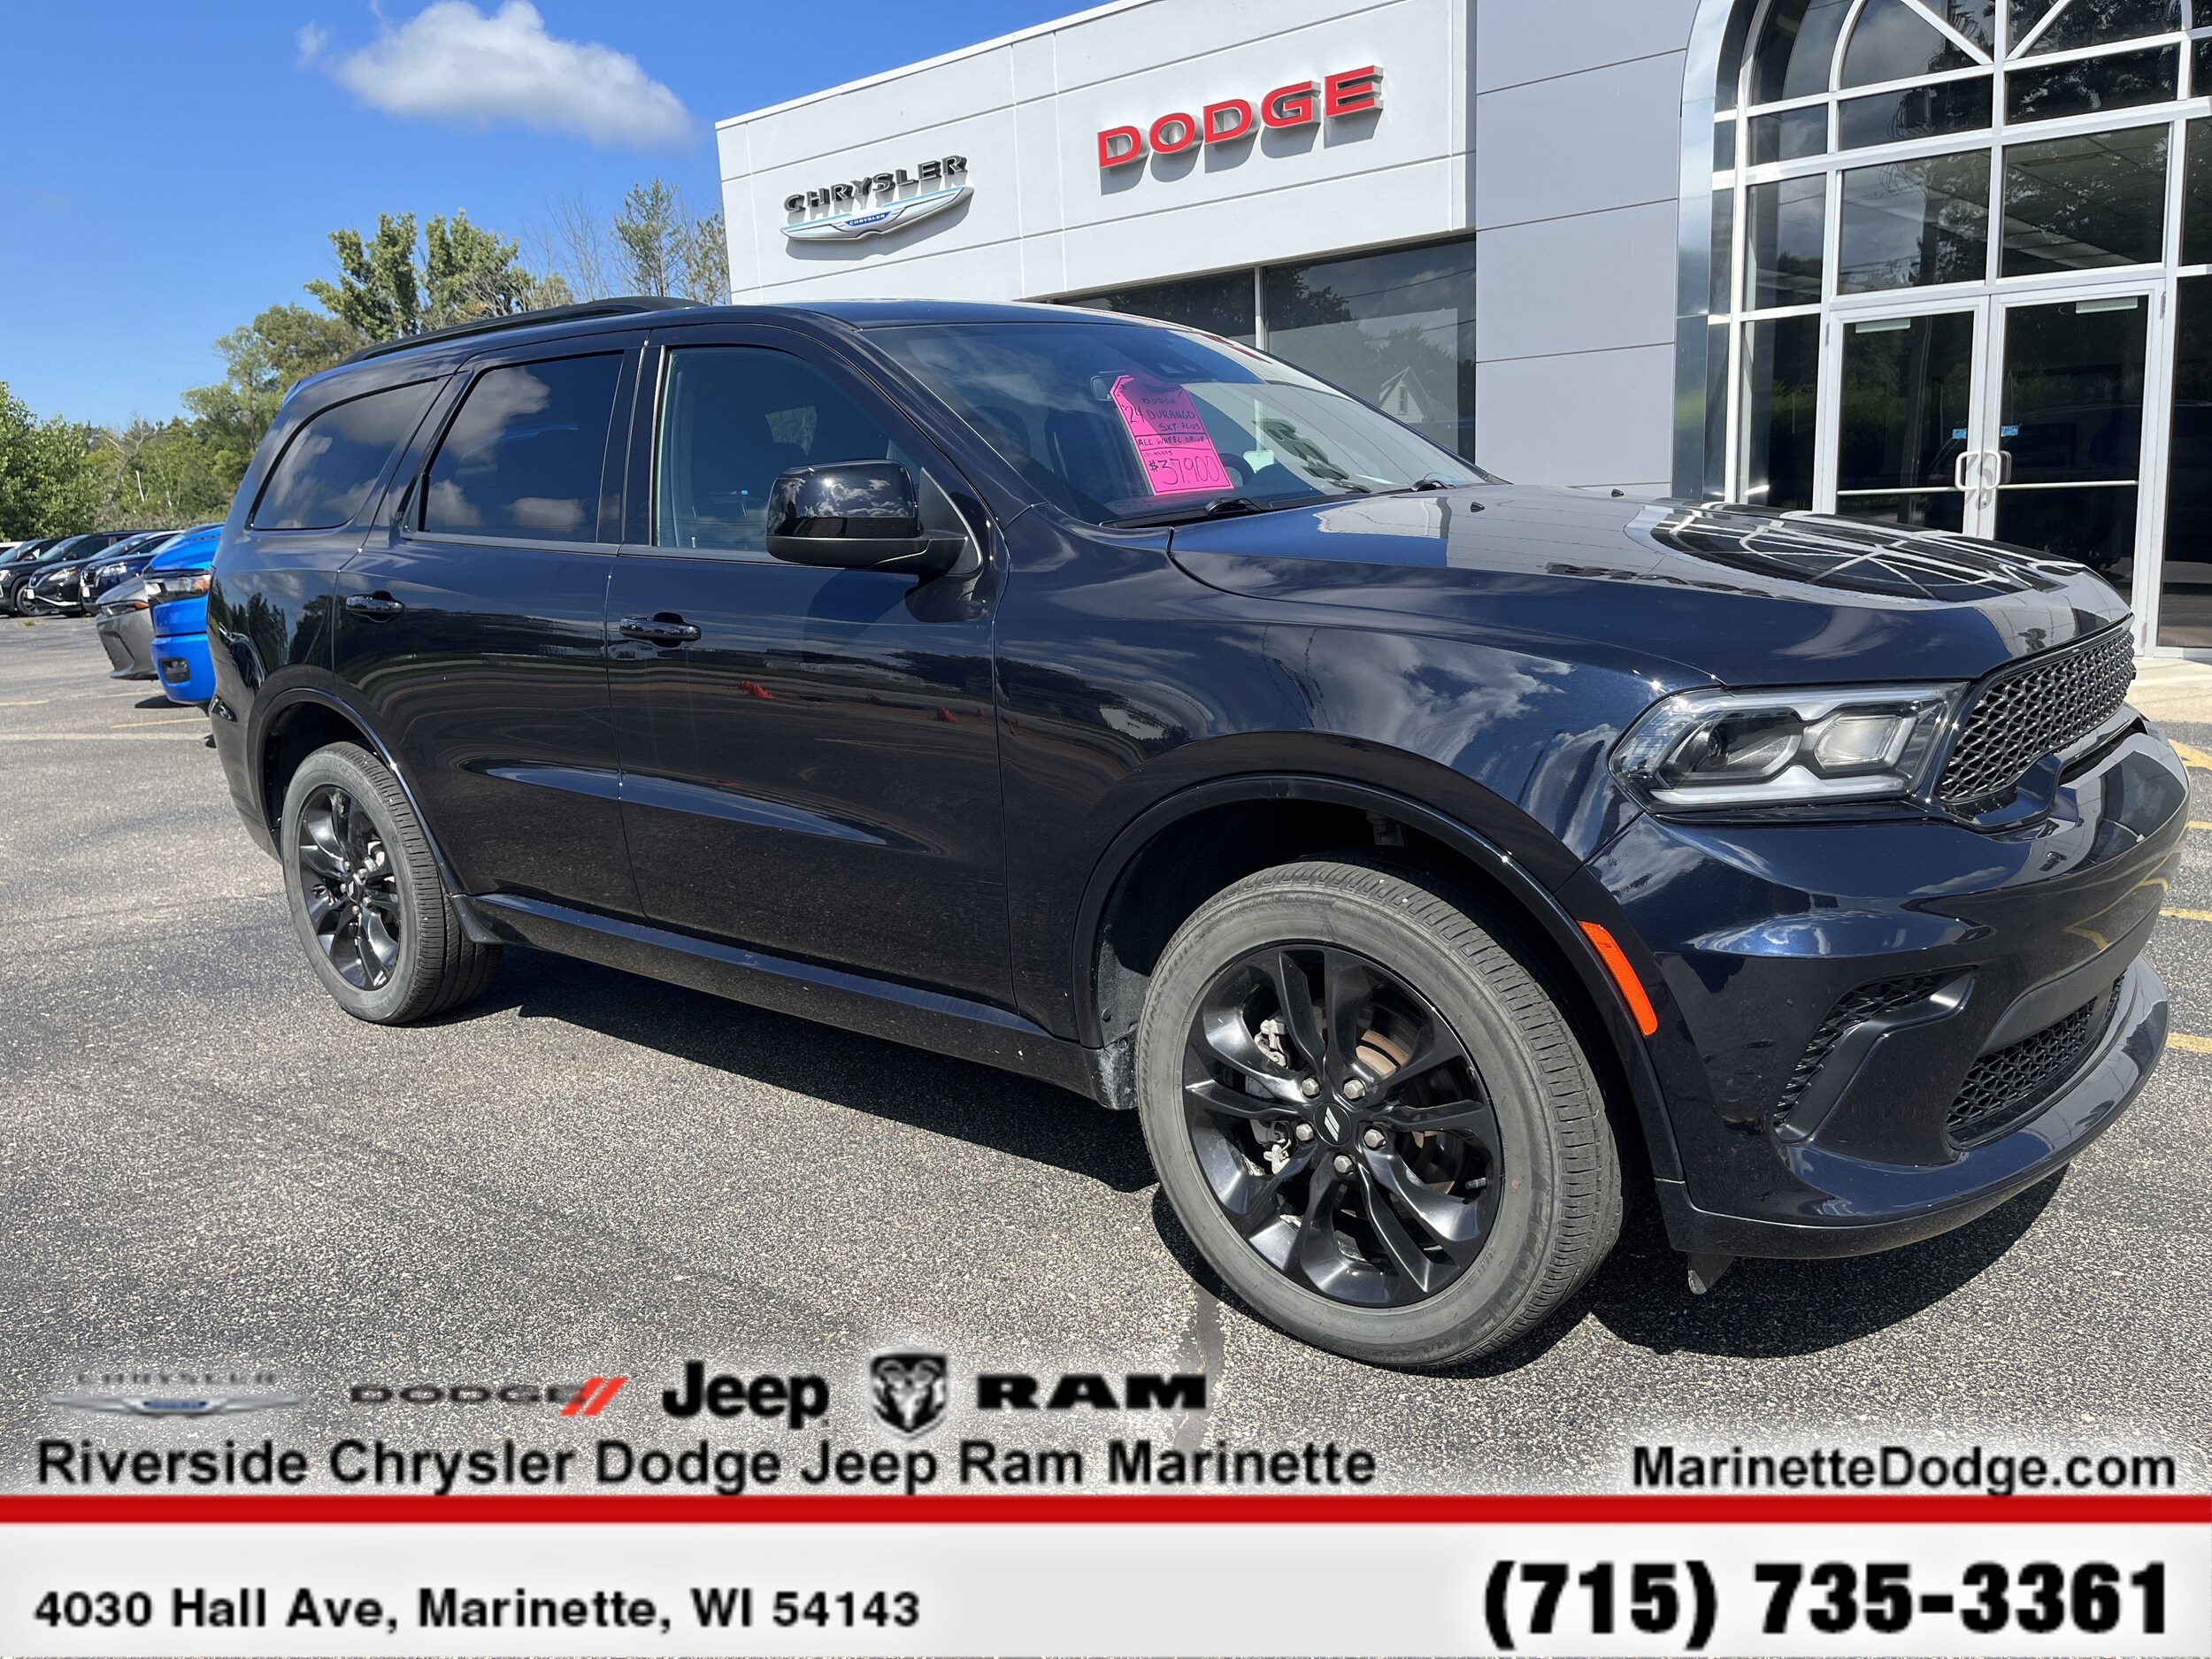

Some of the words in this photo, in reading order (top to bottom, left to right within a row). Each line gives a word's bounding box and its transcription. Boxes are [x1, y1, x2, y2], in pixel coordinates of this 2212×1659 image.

[1097, 65, 1384, 168] DODGE
[784, 154, 967, 212] CHRYSLER
[849, 212, 886, 226] CHRYSLER
[1146, 410, 1195, 420] DURANGO
[1158, 423, 1178, 432] SXT
[1181, 422, 1201, 431] PLUS
